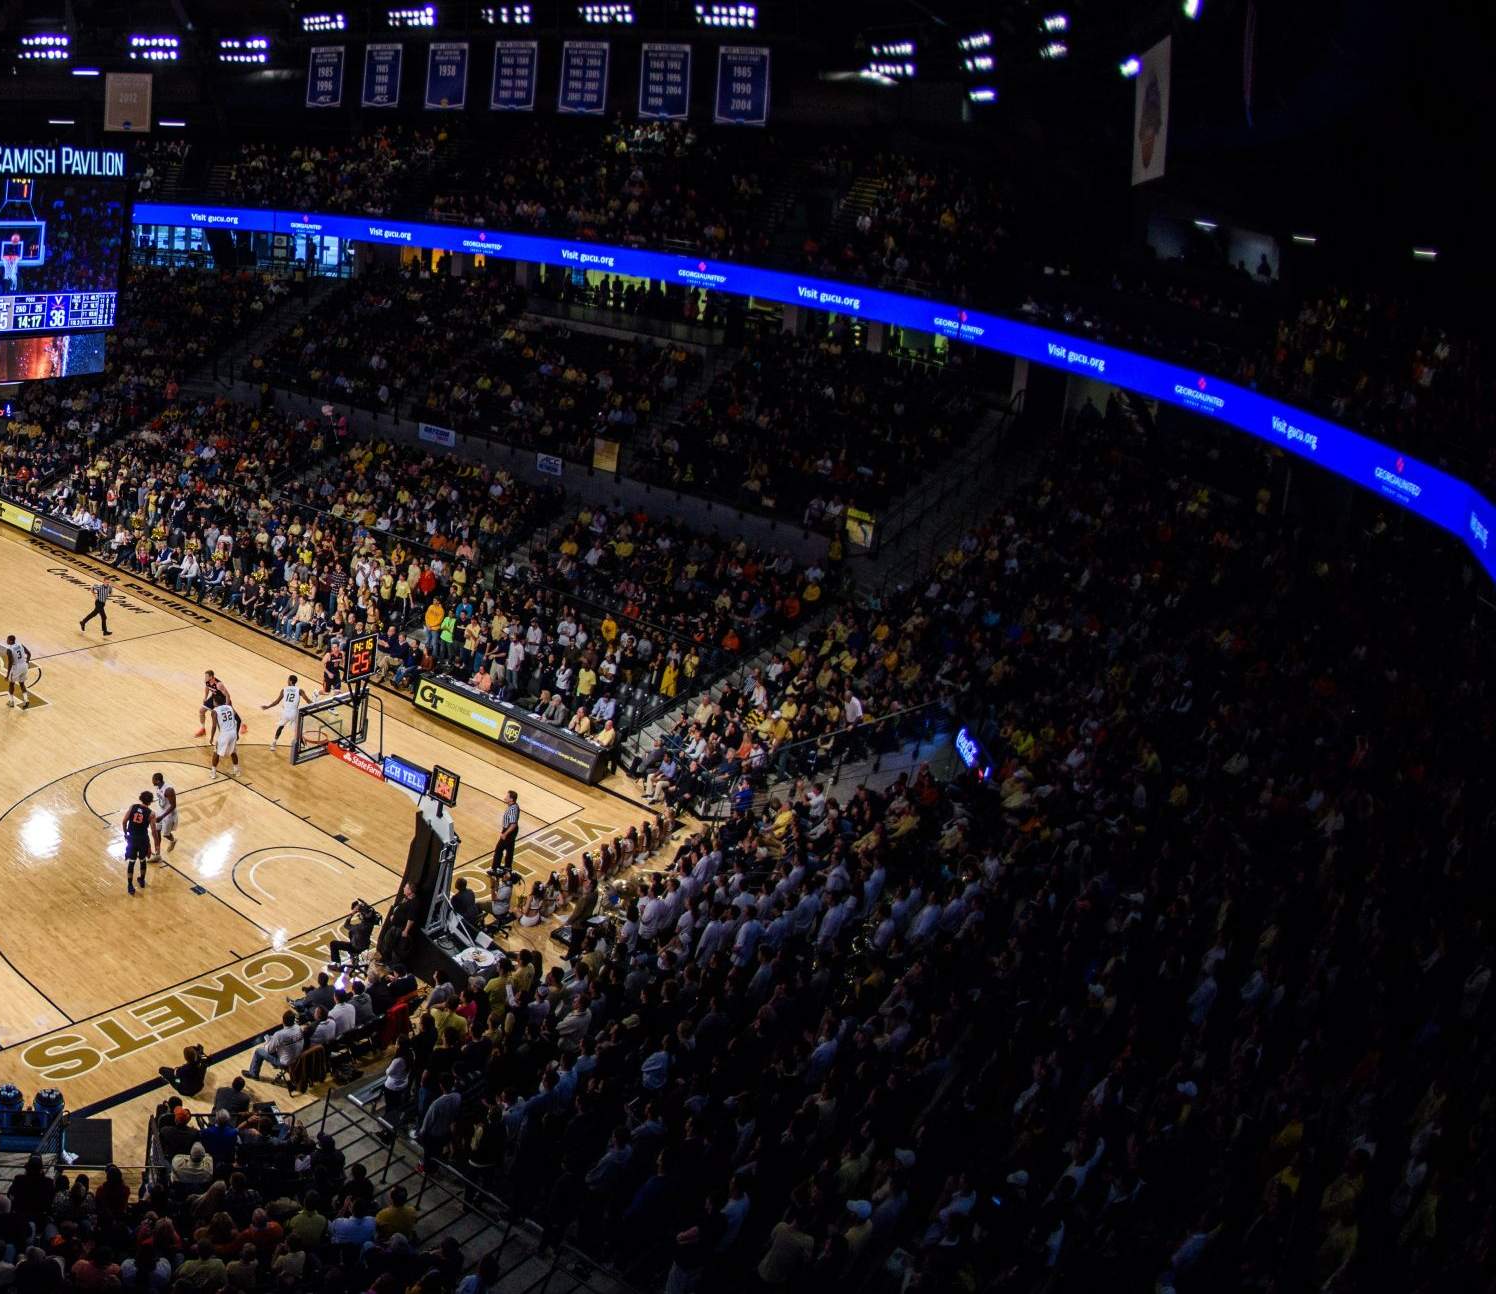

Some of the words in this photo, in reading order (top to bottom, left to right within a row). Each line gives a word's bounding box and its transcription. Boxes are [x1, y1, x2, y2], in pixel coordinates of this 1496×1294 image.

[318, 66, 334, 77] 1985
[732, 66, 752, 78] 1985
[317, 80, 332, 92] 1996
[666, 86, 682, 95] 2004
[732, 82, 752, 95] 1990
[730, 98, 752, 112] 2004
[62, 147, 124, 176] PAVILION
[191, 213, 206, 221] Visit
[208, 215, 238, 224] gucu.org
[370, 227, 383, 236] Visit
[384, 230, 412, 241] gucu.org
[562, 249, 579, 260] Visit
[580, 253, 615, 268] gucu.org
[798, 285, 818, 300] Visit
[819, 292, 860, 310] gucu.org
[17, 316, 42, 328] 14:17
[50, 310, 65, 327] 36
[1048, 342, 1066, 358] Visit
[1067, 351, 1106, 373] gucu.org
[1272, 415, 1287, 434] Visit
[124, 583, 213, 624] Pavilion
[16, 650, 22, 660] 3
[352, 652, 371, 674] 25
[286, 693, 295, 702] 12
[420, 684, 444, 710] GT
[222, 710, 232, 722] 32
[505, 726, 520, 739] ups
[133, 812, 144, 824] 13
